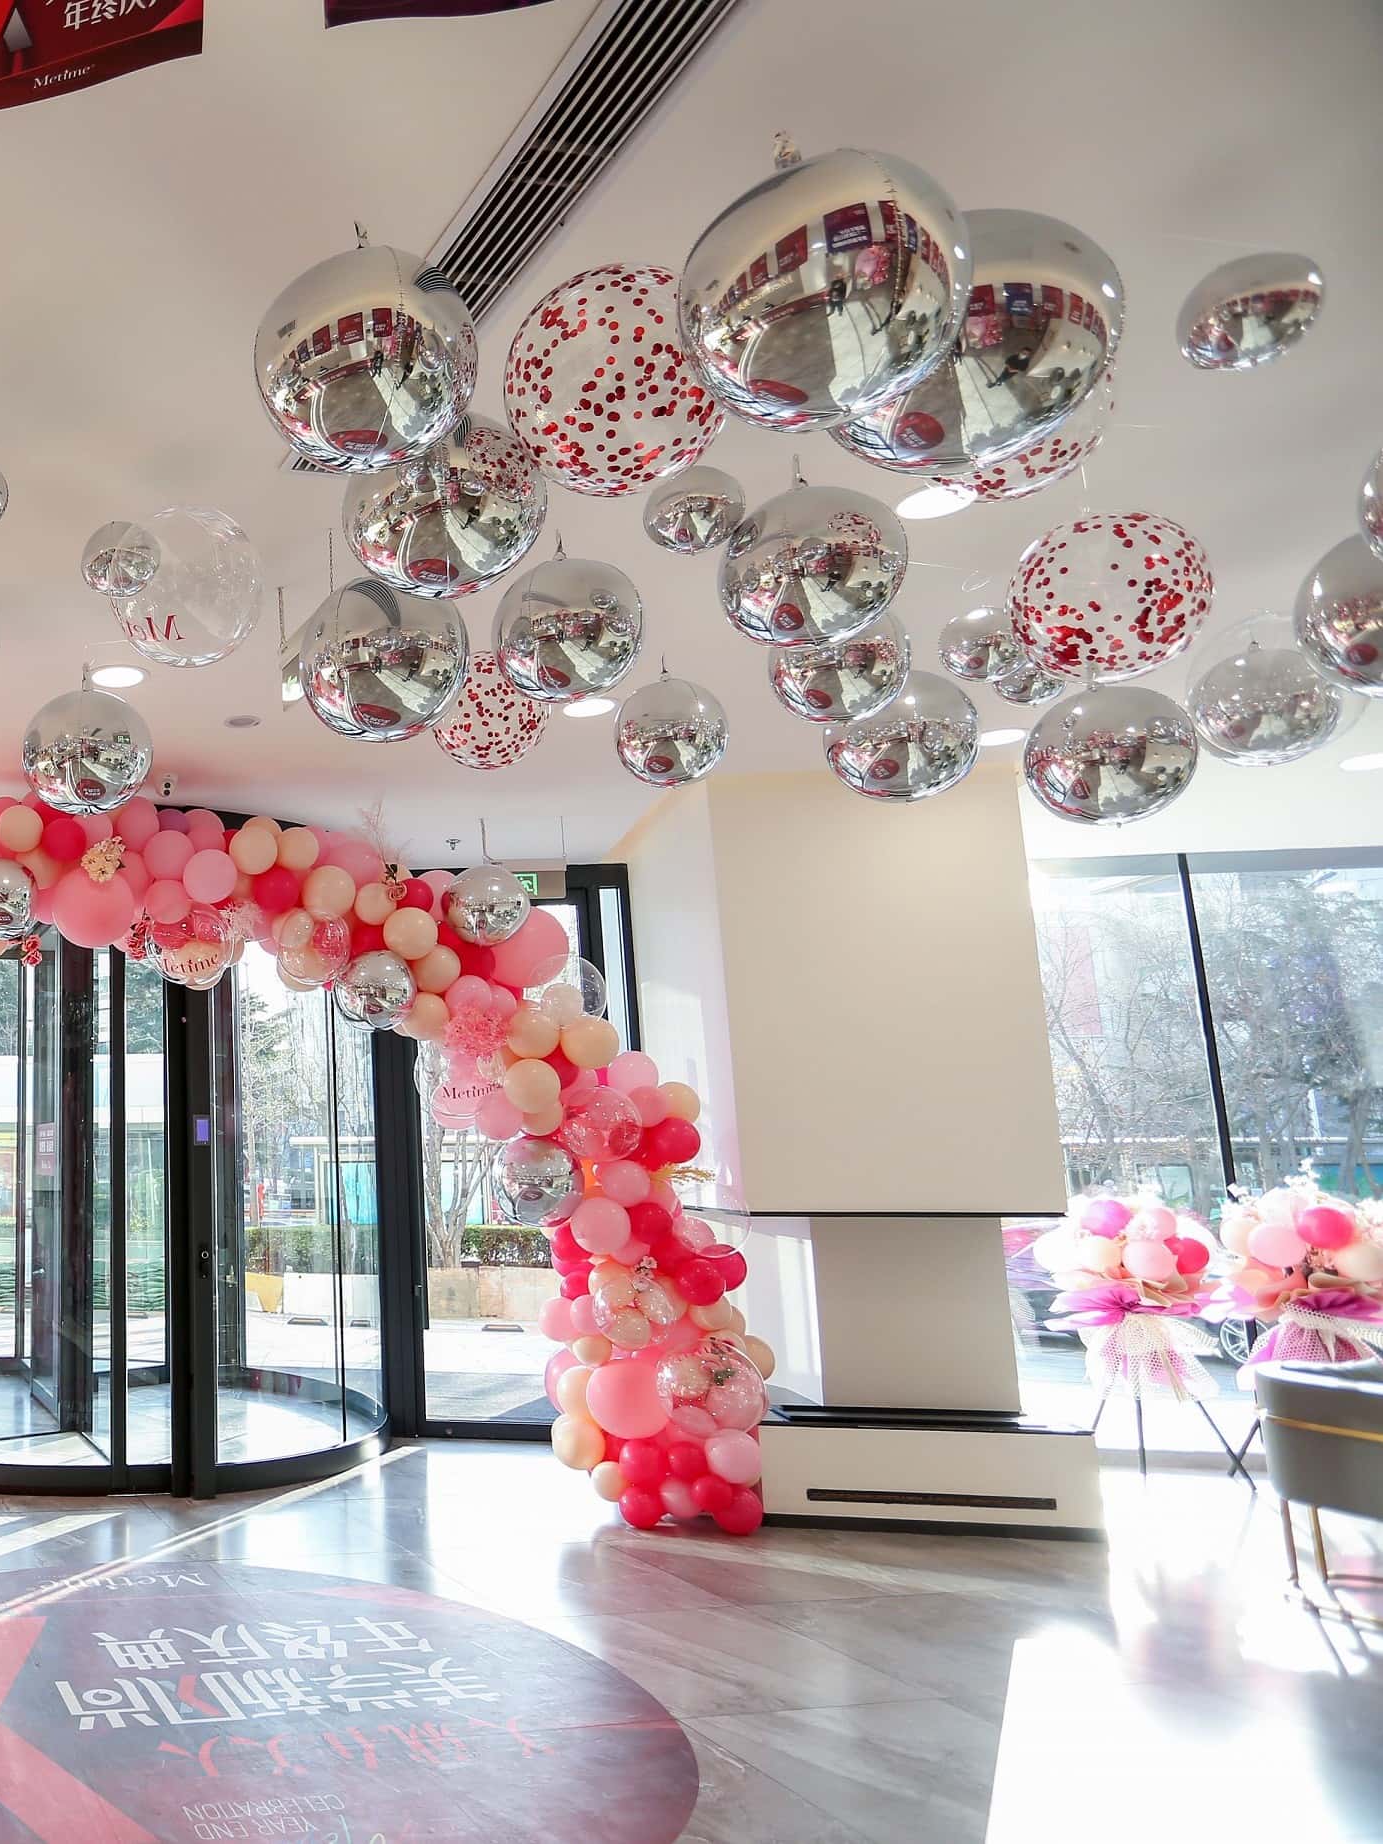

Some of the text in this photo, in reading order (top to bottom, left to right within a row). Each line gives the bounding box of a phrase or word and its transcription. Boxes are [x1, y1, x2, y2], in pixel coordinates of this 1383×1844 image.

[91, 1615, 434, 1670] 年终庆典
[181, 1793, 346, 1822] CELEBRATION
[193, 1819, 250, 1841] END
[251, 1814, 320, 1837] YEAR
